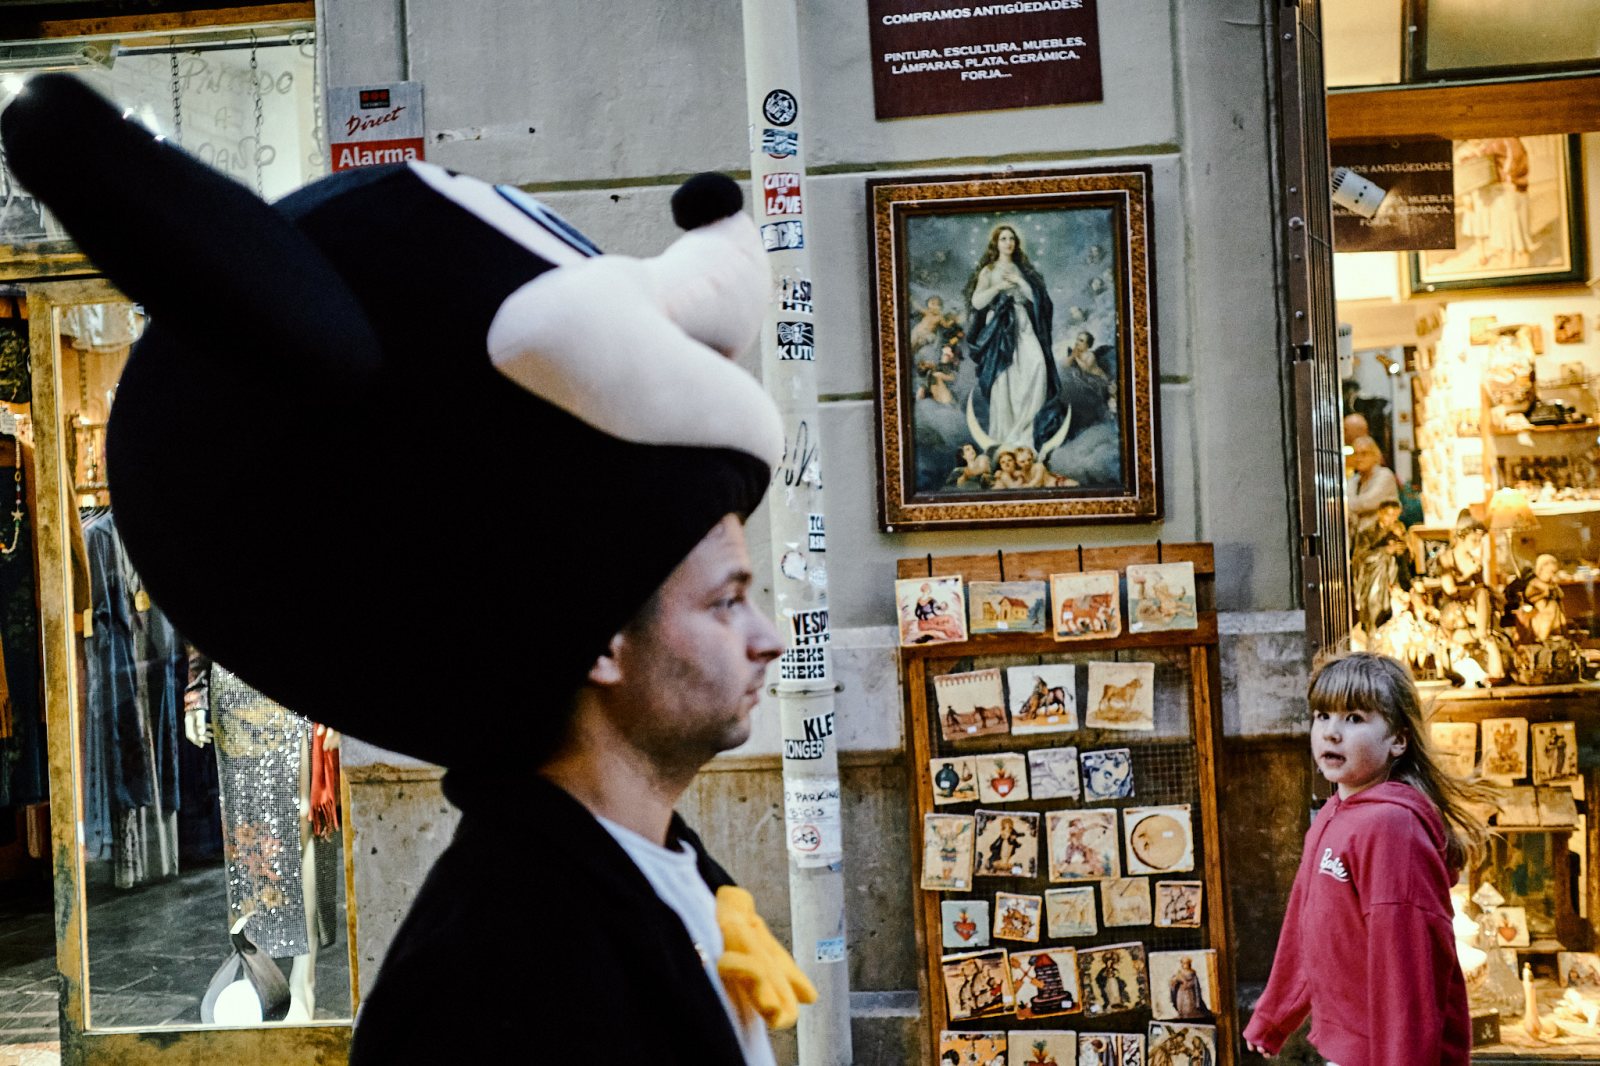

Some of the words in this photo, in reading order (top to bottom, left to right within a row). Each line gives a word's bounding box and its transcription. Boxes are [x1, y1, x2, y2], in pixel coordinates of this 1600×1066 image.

[882, 8, 972, 25] COMPRAMOS
[345, 106, 406, 136] Direct
[339, 146, 417, 168] Alarma
[767, 195, 801, 214] LOVE
[793, 611, 829, 636] VESP
